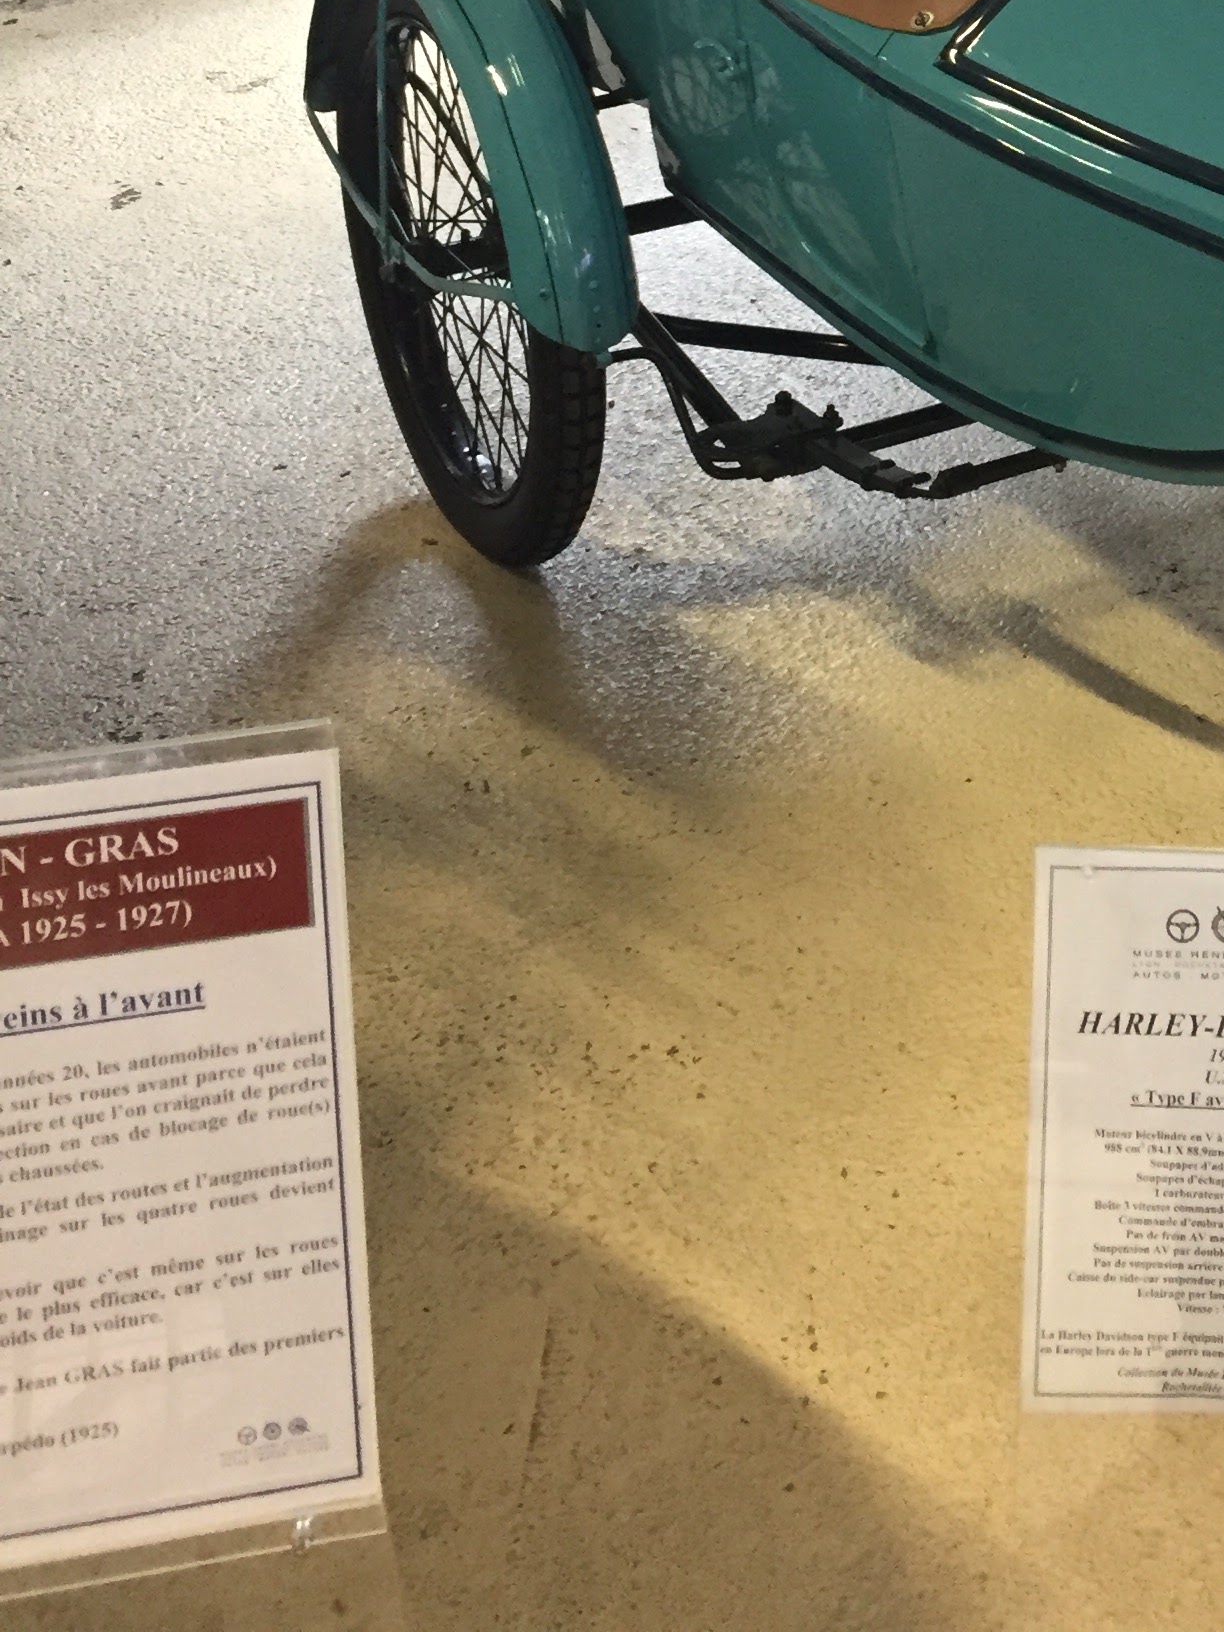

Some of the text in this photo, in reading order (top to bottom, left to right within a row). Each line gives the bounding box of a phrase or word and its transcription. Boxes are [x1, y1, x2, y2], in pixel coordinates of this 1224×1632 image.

[64, 827, 179, 867] GRAS
[20, 887, 68, 909] Issy
[77, 880, 110, 901] les
[119, 856, 277, 895] Moulineaux)
[21, 913, 86, 944] 1925
[117, 900, 192, 931] 1927)
[3, 982, 203, 1030] eins à l'avant
[96, 1060, 121, 1076] les
[128, 1043, 239, 1071] automobiles
[246, 1029, 325, 1054] n'étaient
[10, 1097, 38, 1111] sur
[47, 1091, 73, 1106] les
[79, 1085, 130, 1102] roues
[136, 1073, 188, 1094] avant
[195, 1067, 246, 1088] parce
[252, 1061, 286, 1079] que
[292, 1052, 327, 1070] cela
[48, 1076, 329, 1130] et que l'on craignait de perdre
[1144, 1089, 1186, 1109] Type
[1190, 1091, 1200, 1106] F
[59, 1137, 81, 1151] en
[90, 1132, 120, 1147] cas
[128, 1124, 151, 1141] de
[158, 1116, 228, 1137] blocage
[236, 1108, 258, 1125] de
[58, 1219, 87, 1232] sur
[100, 1212, 125, 1227] les
[135, 1201, 197, 1225] quatre
[209, 1192, 258, 1210] roues
[269, 1177, 334, 1200] devient
[74, 1191, 105, 1208] des
[111, 1183, 168, 1203] routes
[172, 1177, 190, 1192] et
[52, 1276, 86, 1295] que
[150, 1257, 205, 1276] même
[215, 1251, 245, 1266] sur
[254, 1245, 279, 1259] les
[289, 1236, 338, 1254] roues
[15, 1306, 32, 1322] le
[41, 1300, 81, 1323] plus
[301, 1258, 340, 1276] elles
[42, 1324, 65, 1342] de
[69, 1322, 87, 1336] la
[14, 1327, 344, 1393] Jean GRAS fait partie des premiers
[59, 1421, 119, 1448] (1925)
